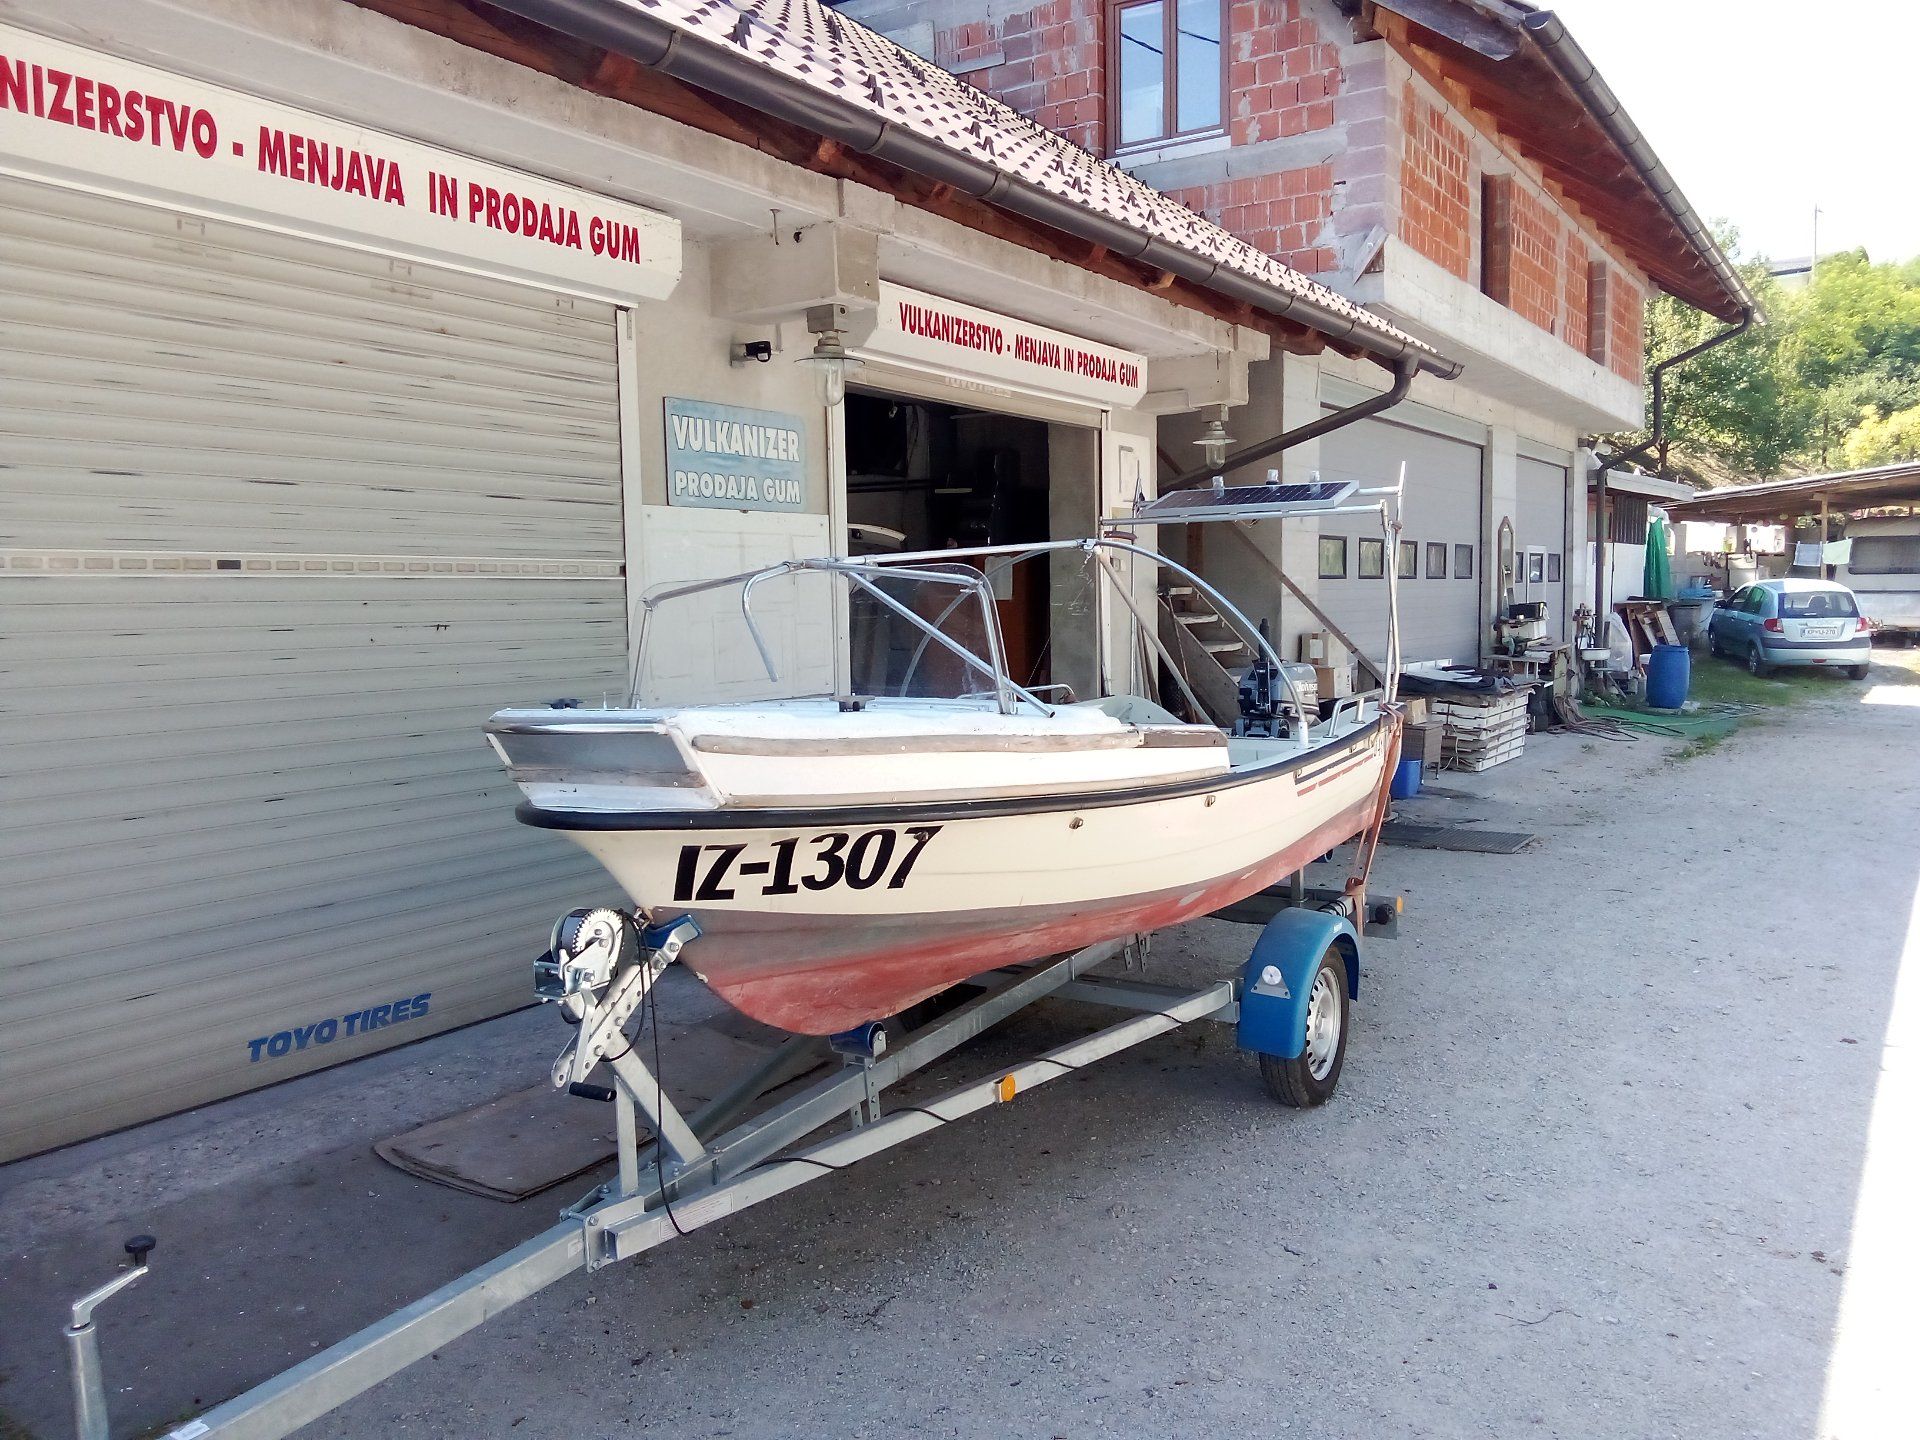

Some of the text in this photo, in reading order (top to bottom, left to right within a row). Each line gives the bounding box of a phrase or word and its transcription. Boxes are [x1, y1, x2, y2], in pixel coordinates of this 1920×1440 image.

[0, 55, 218, 159] NIZERSTVO
[258, 125, 406, 207] MENJAVA
[429, 171, 458, 220] IN
[469, 182, 582, 250] PRODAJA
[589, 216, 641, 264] GUM
[899, 301, 1003, 355] VULKANIZERSTVO
[1015, 333, 1061, 370] MENJAVA
[1063, 347, 1074, 373] IN
[1077, 351, 1117, 383] PRODAJA
[1119, 362, 1139, 388] GUM
[671, 413, 800, 462] VULKANIZER
[675, 470, 801, 504] PRODAJA GUM
[673, 824, 945, 902] IZ-1307
[247, 992, 432, 1063] TOYO TIRES
